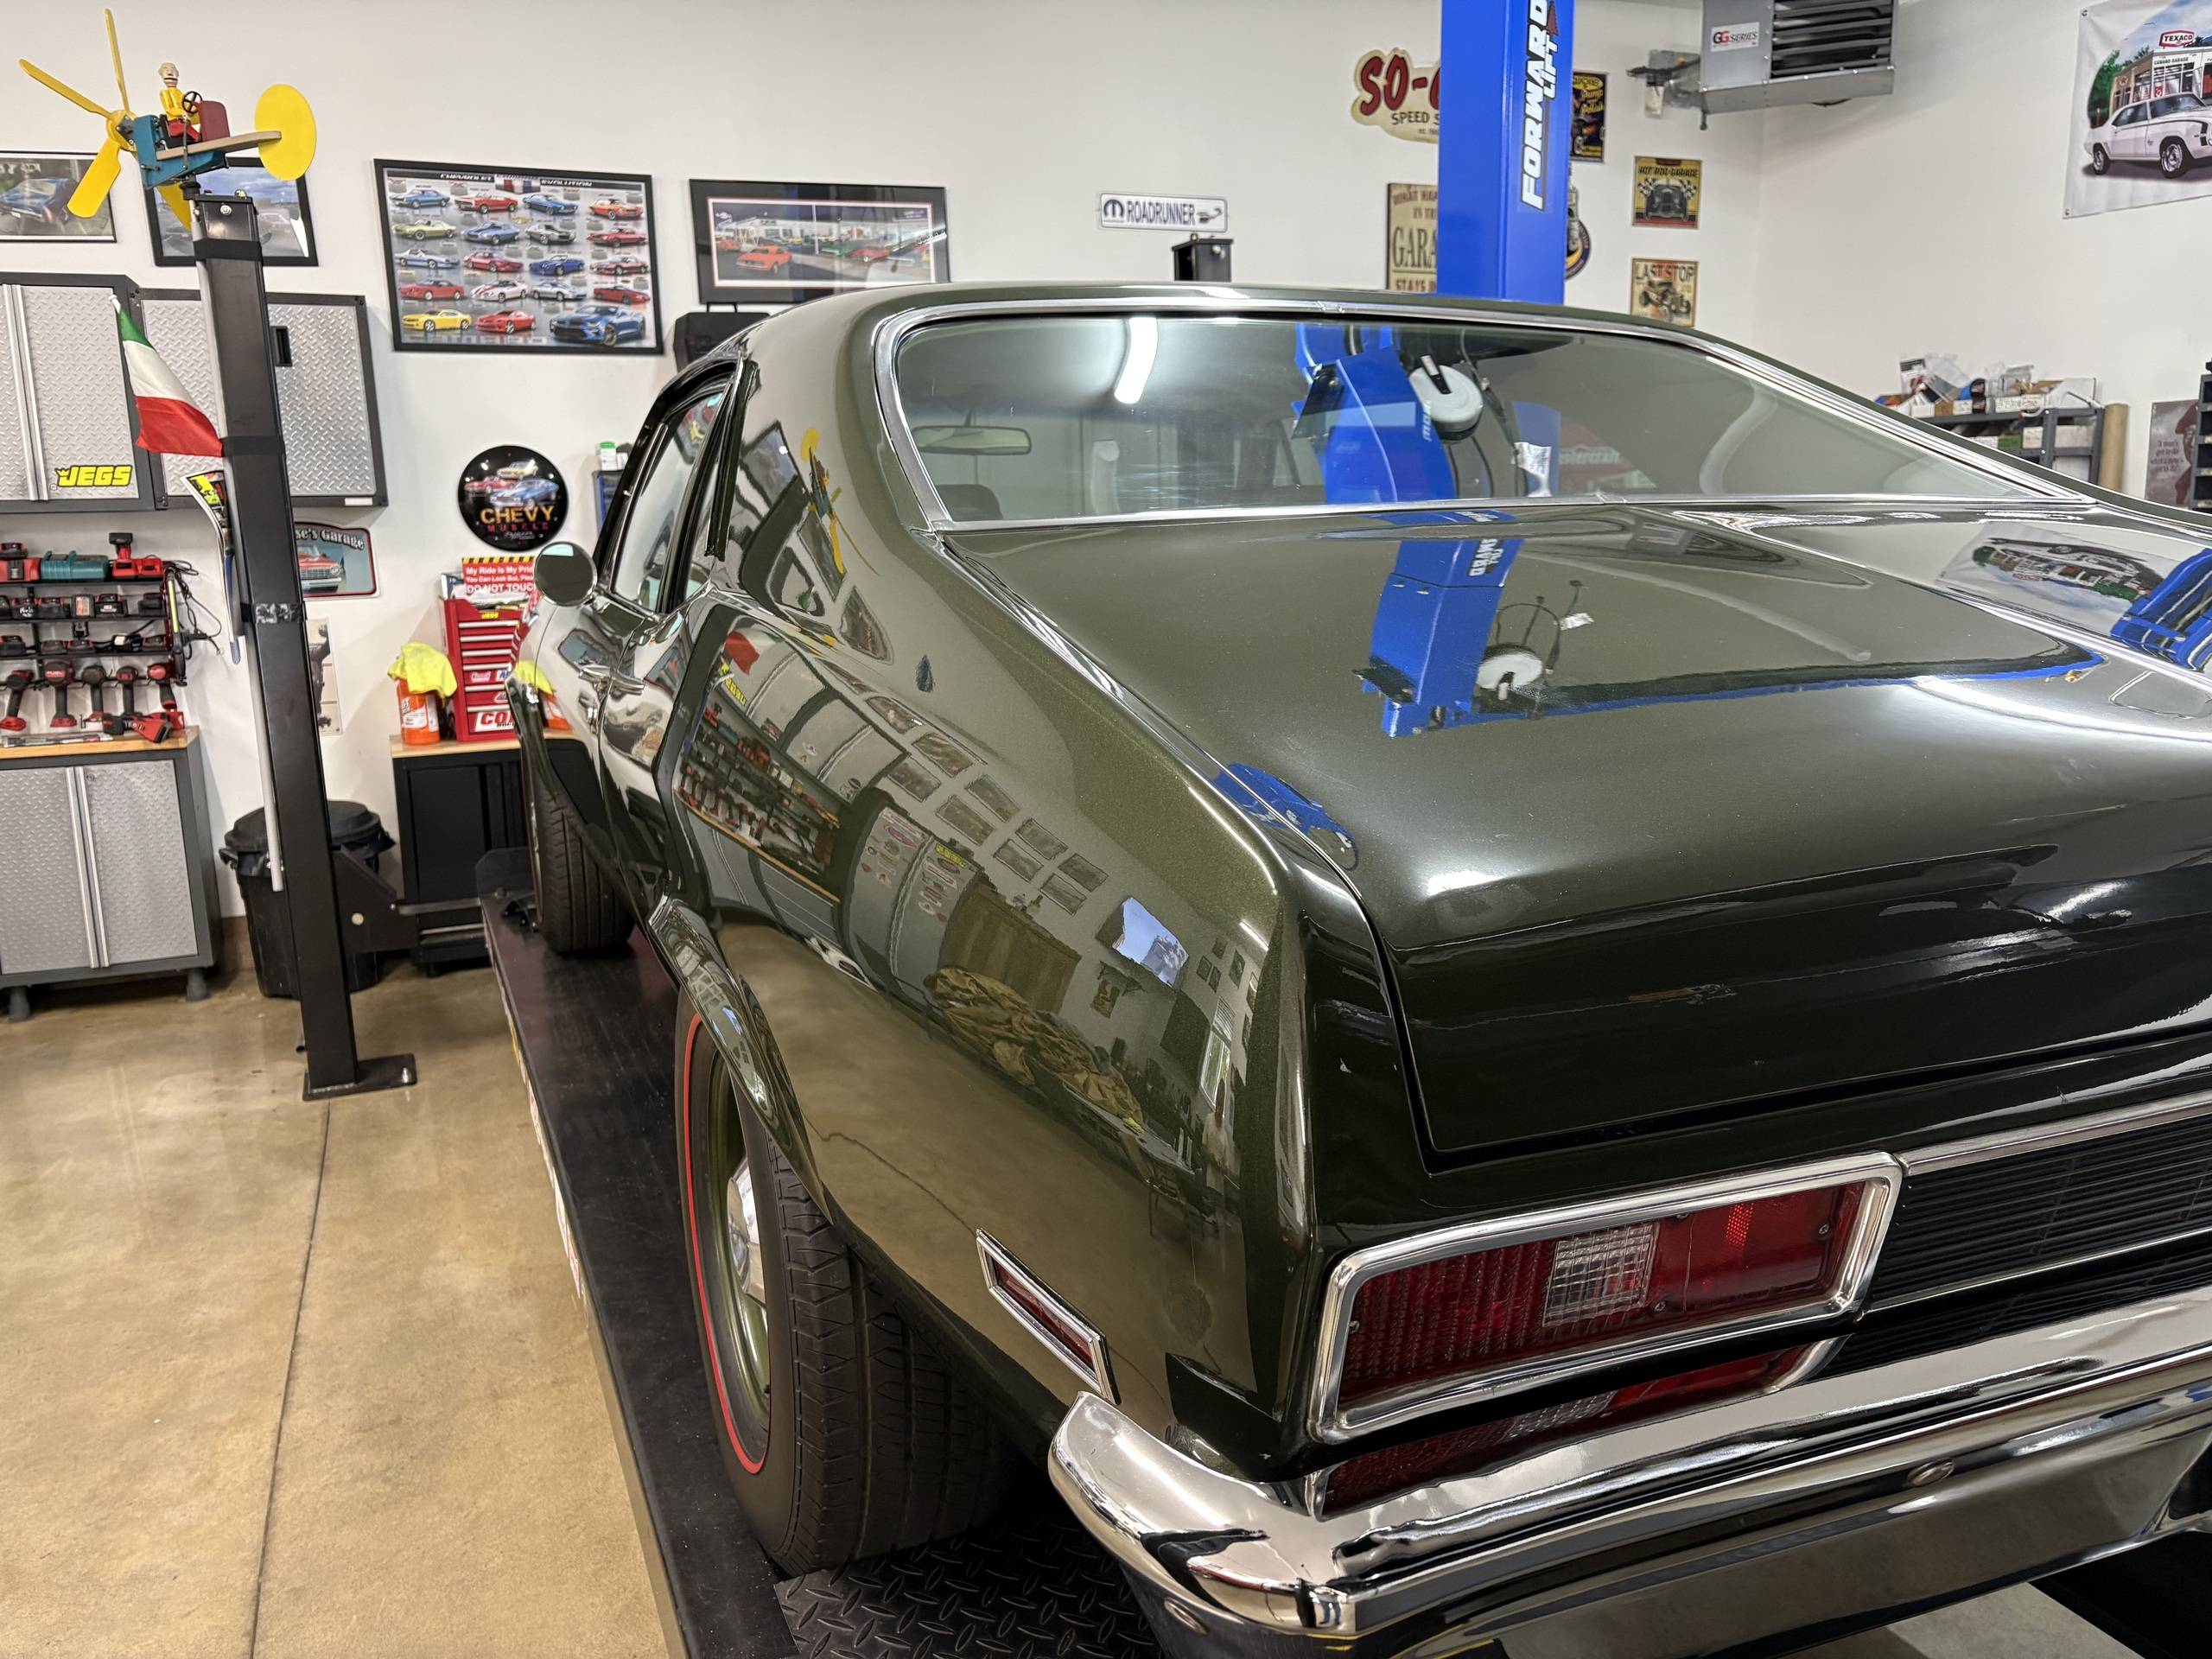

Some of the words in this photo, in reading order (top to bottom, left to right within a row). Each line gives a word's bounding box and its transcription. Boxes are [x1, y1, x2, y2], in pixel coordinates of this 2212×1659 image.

[1543, 33, 1558, 99] LIFT
[1522, 0, 1548, 210] FORWARD
[1391, 111, 1430, 125] SPEED
[1127, 200, 1196, 226] ROADRUNNER
[1392, 226, 1437, 269] GARA
[57, 465, 132, 487] JEGS
[480, 505, 554, 524] CHEVY
[487, 521, 549, 532] MUSCLE
[320, 529, 365, 550] Garage
[467, 567, 478, 575] My
[479, 566, 497, 575] Ride
[506, 566, 518, 575] My
[467, 583, 481, 594] DO
[483, 583, 505, 594] NOT
